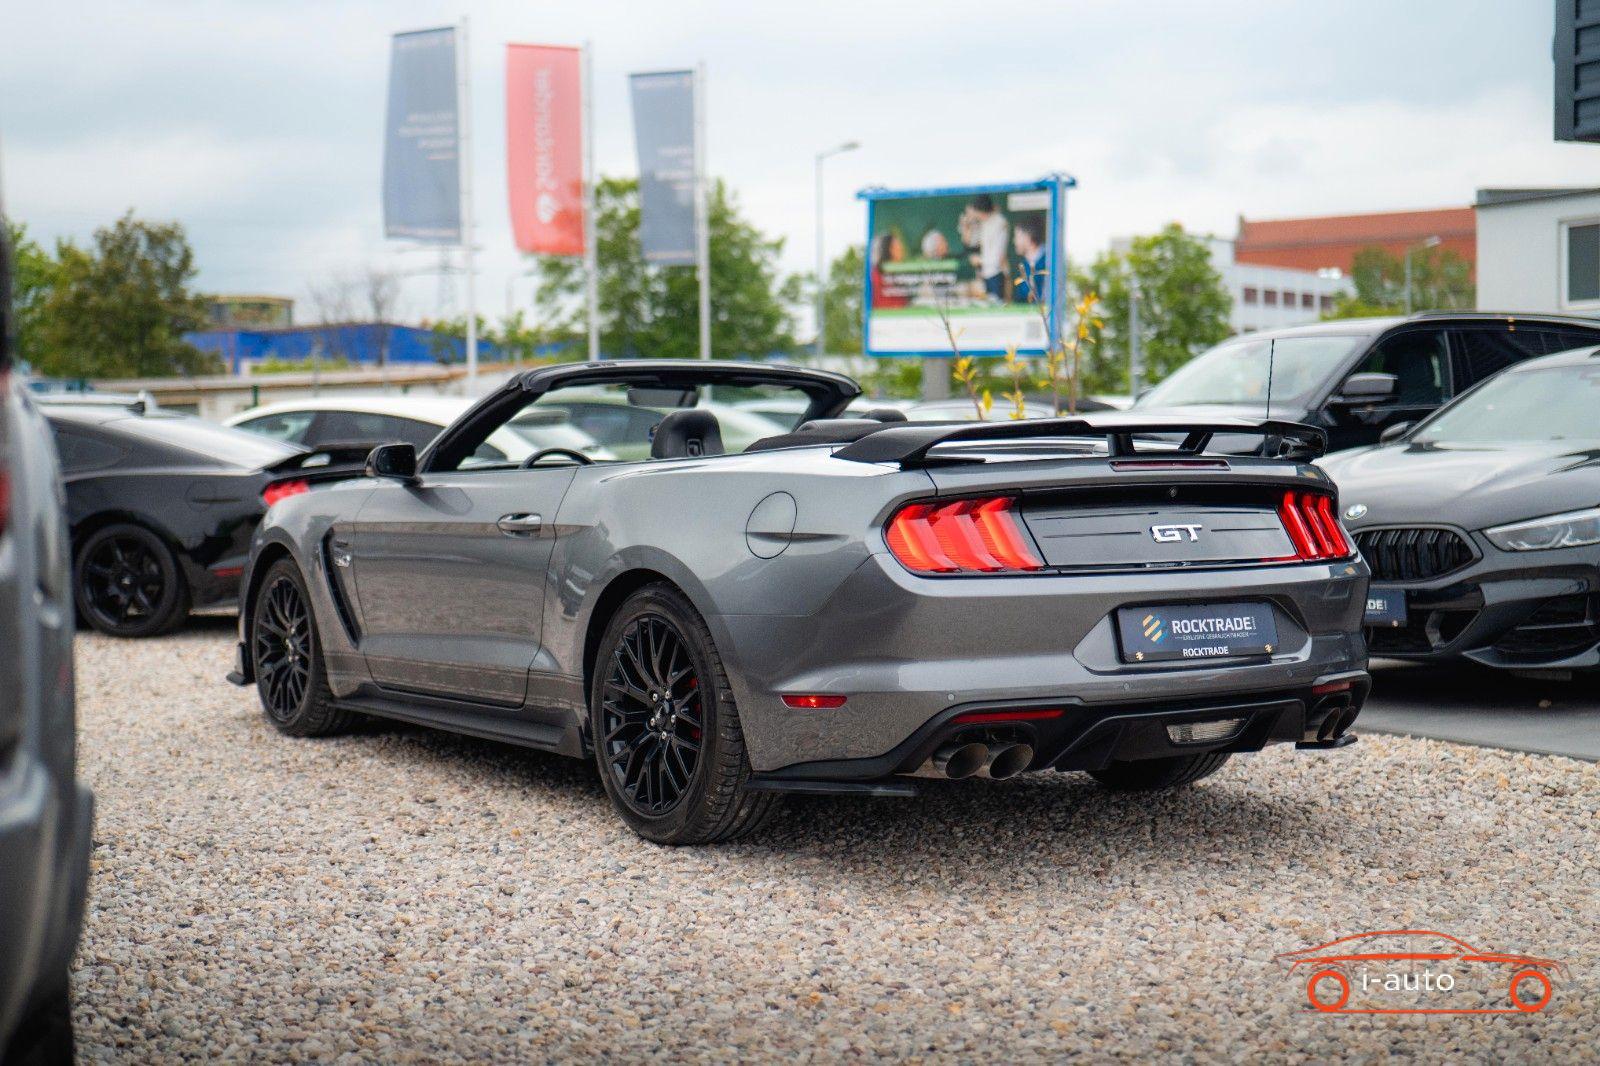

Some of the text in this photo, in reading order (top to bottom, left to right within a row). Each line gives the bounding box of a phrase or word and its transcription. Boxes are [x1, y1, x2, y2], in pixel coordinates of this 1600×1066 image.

[1149, 524, 1203, 543] GT
[1171, 616, 1252, 634] ROCKTRADE
[1183, 646, 1229, 657] ROCKTRADE
